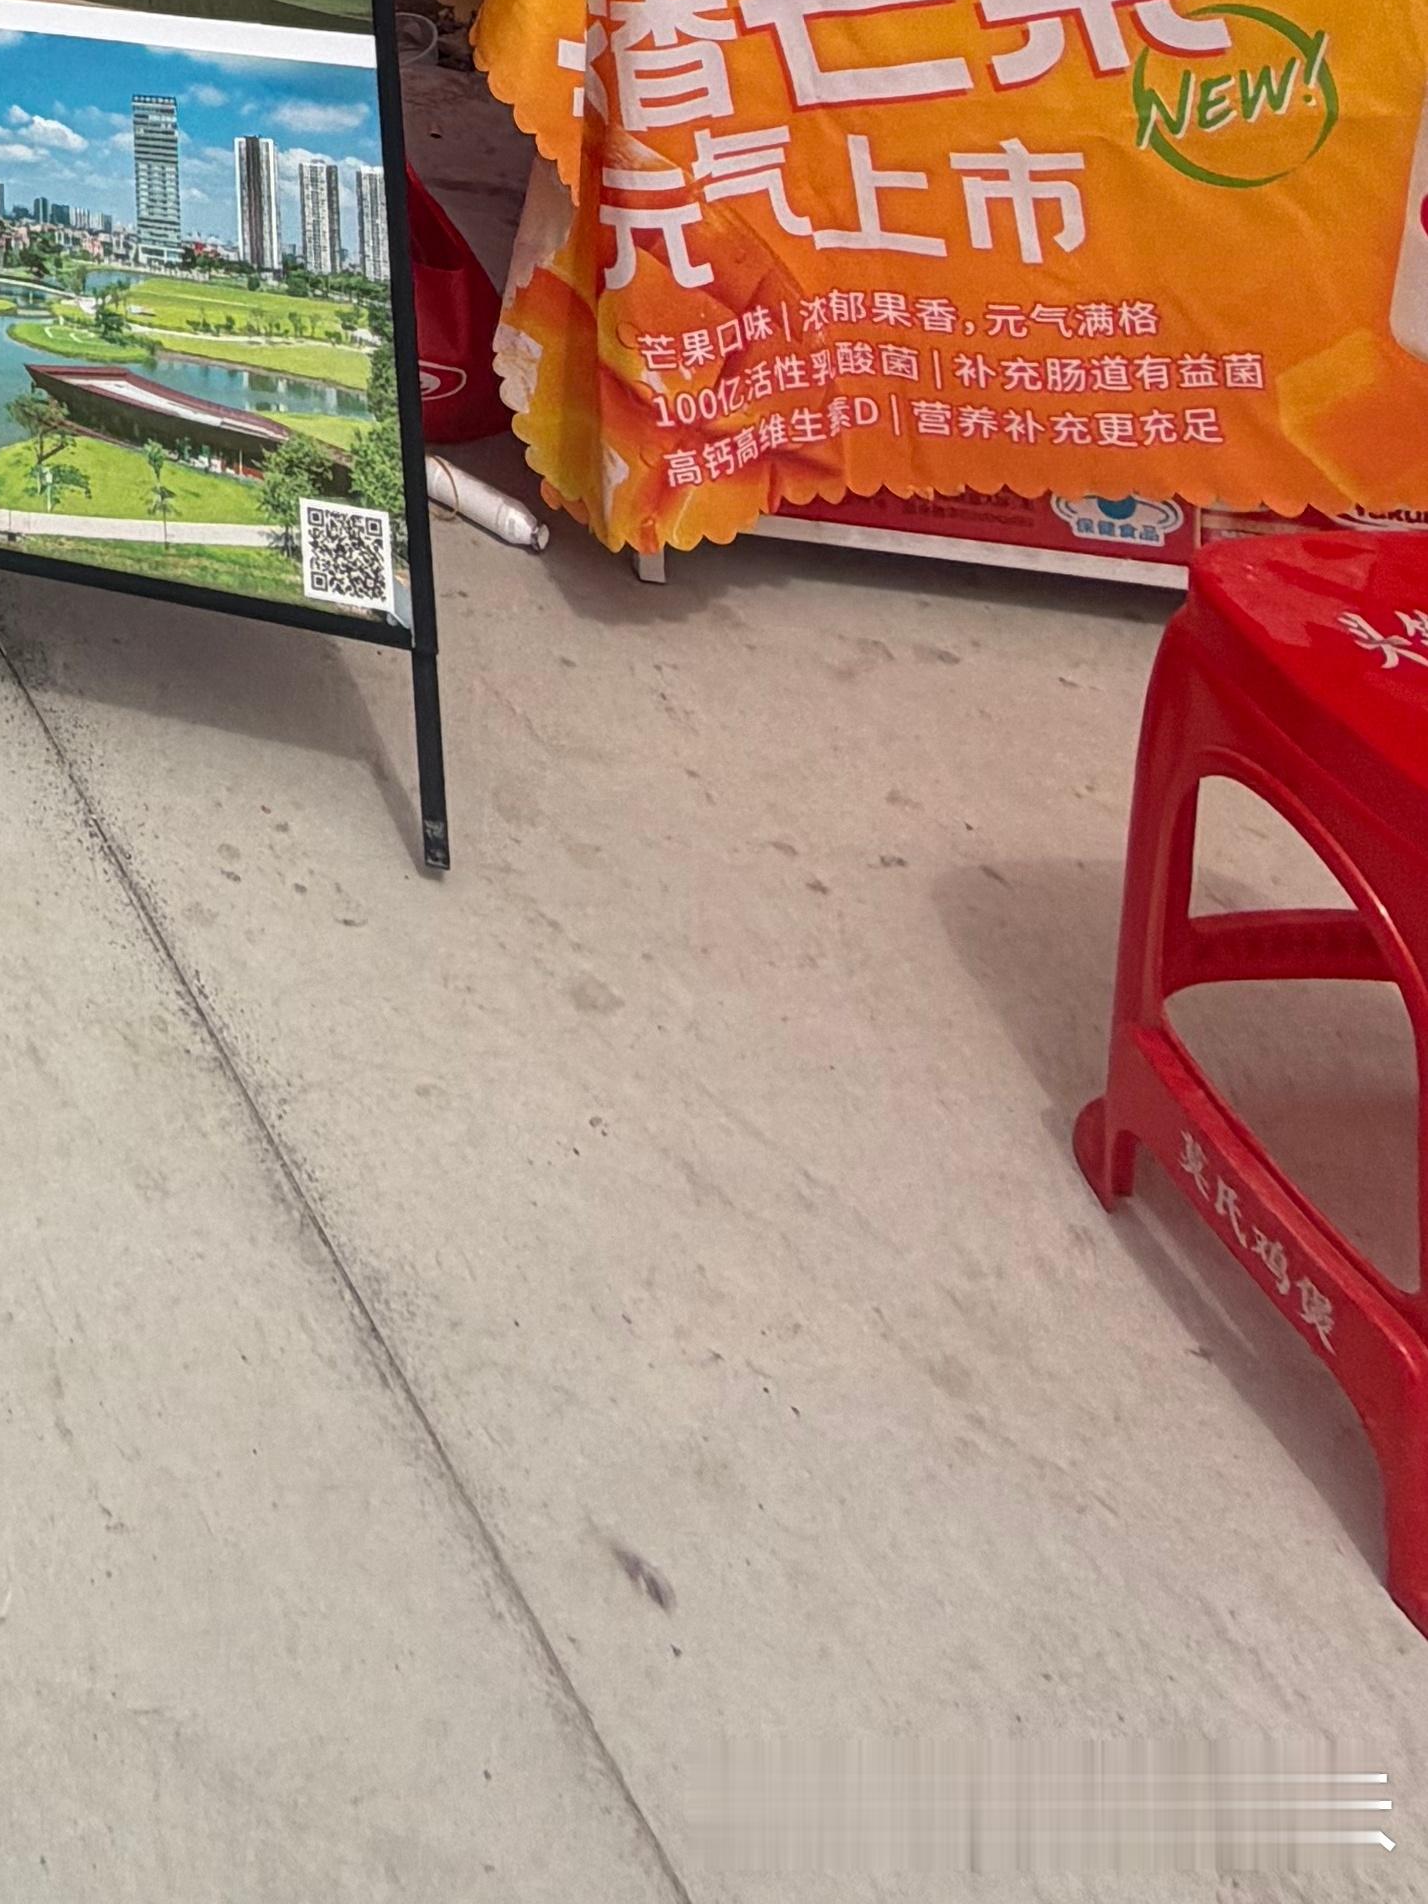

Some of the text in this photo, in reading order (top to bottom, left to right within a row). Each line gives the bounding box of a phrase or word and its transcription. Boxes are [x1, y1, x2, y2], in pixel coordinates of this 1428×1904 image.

[1134, 30, 1327, 149] NEW!
[598, 125, 1087, 291] 元气上市
[637, 306, 774, 376] 芒果口味
[652, 342, 1265, 432] 100亿活性乳酸菌 补充肠道有益菌
[666, 396, 1226, 489] 高钙高维生素D 营养补充更充足
[1075, 516, 1162, 544] 保健食品
[1178, 1129, 1338, 1360] 莫氏鸡煲
